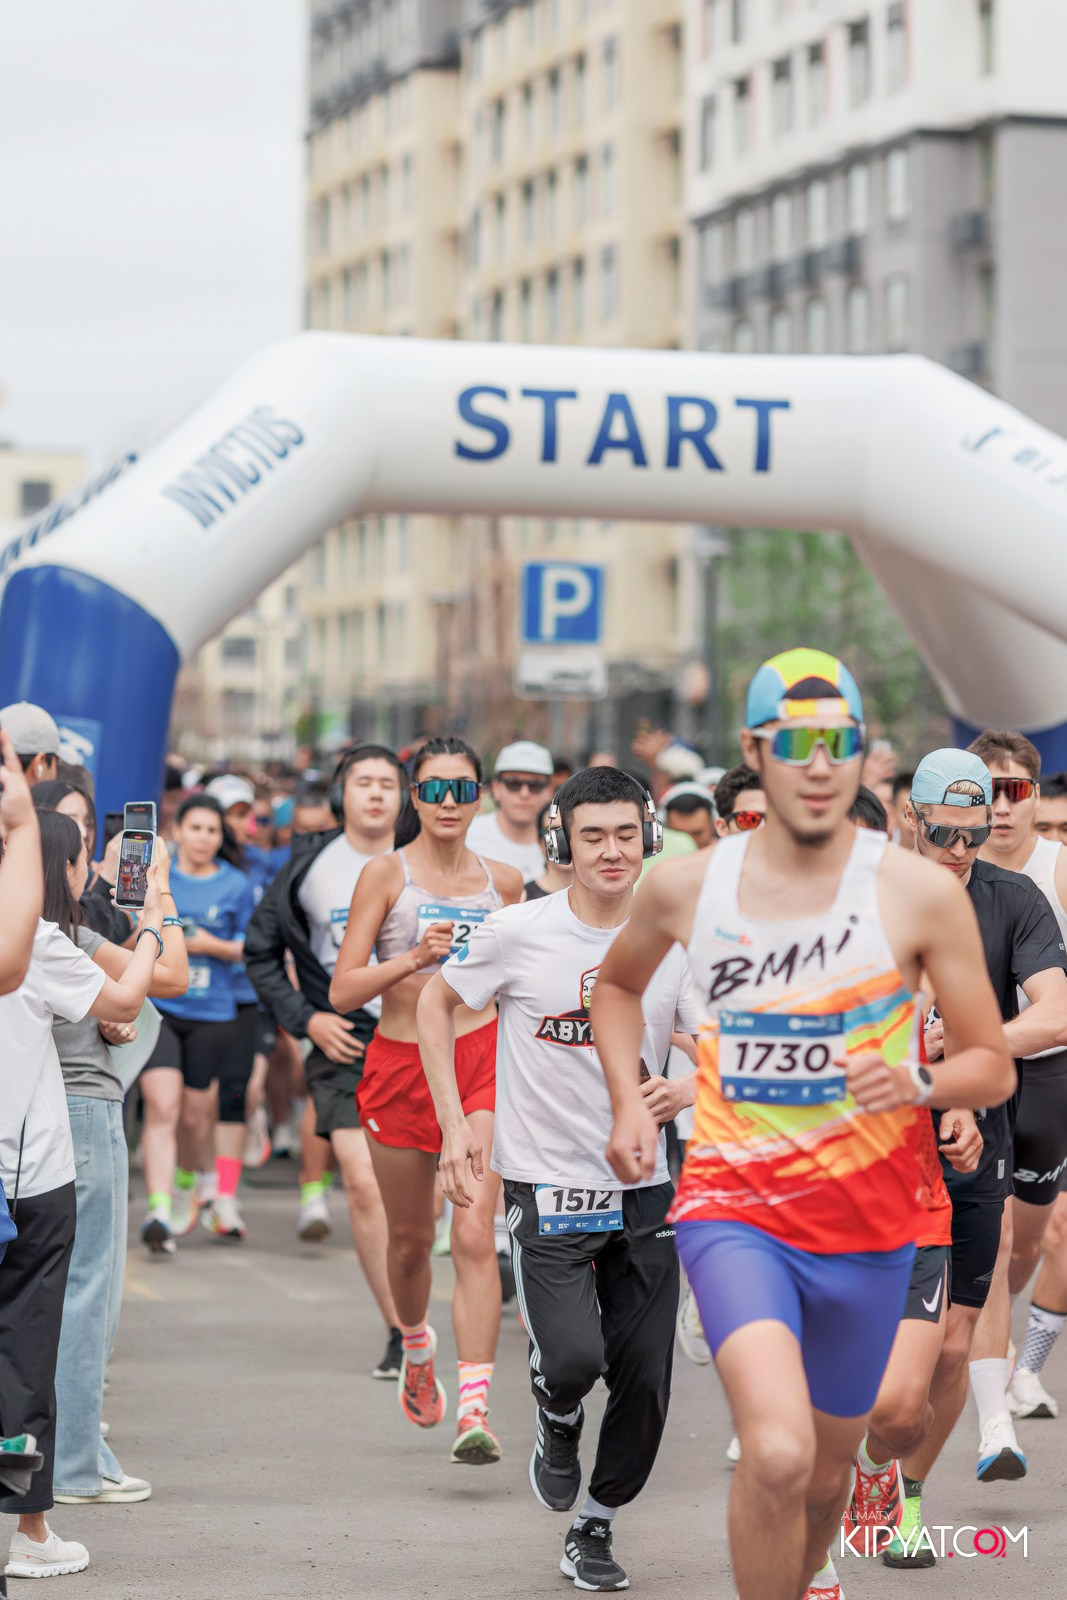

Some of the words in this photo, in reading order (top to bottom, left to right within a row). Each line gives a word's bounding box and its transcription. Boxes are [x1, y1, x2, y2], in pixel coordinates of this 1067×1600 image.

[454, 384, 791, 473] START
[541, 567, 593, 638] P
[736, 1042, 831, 1073] 1730
[552, 1189, 614, 1213] 1512
